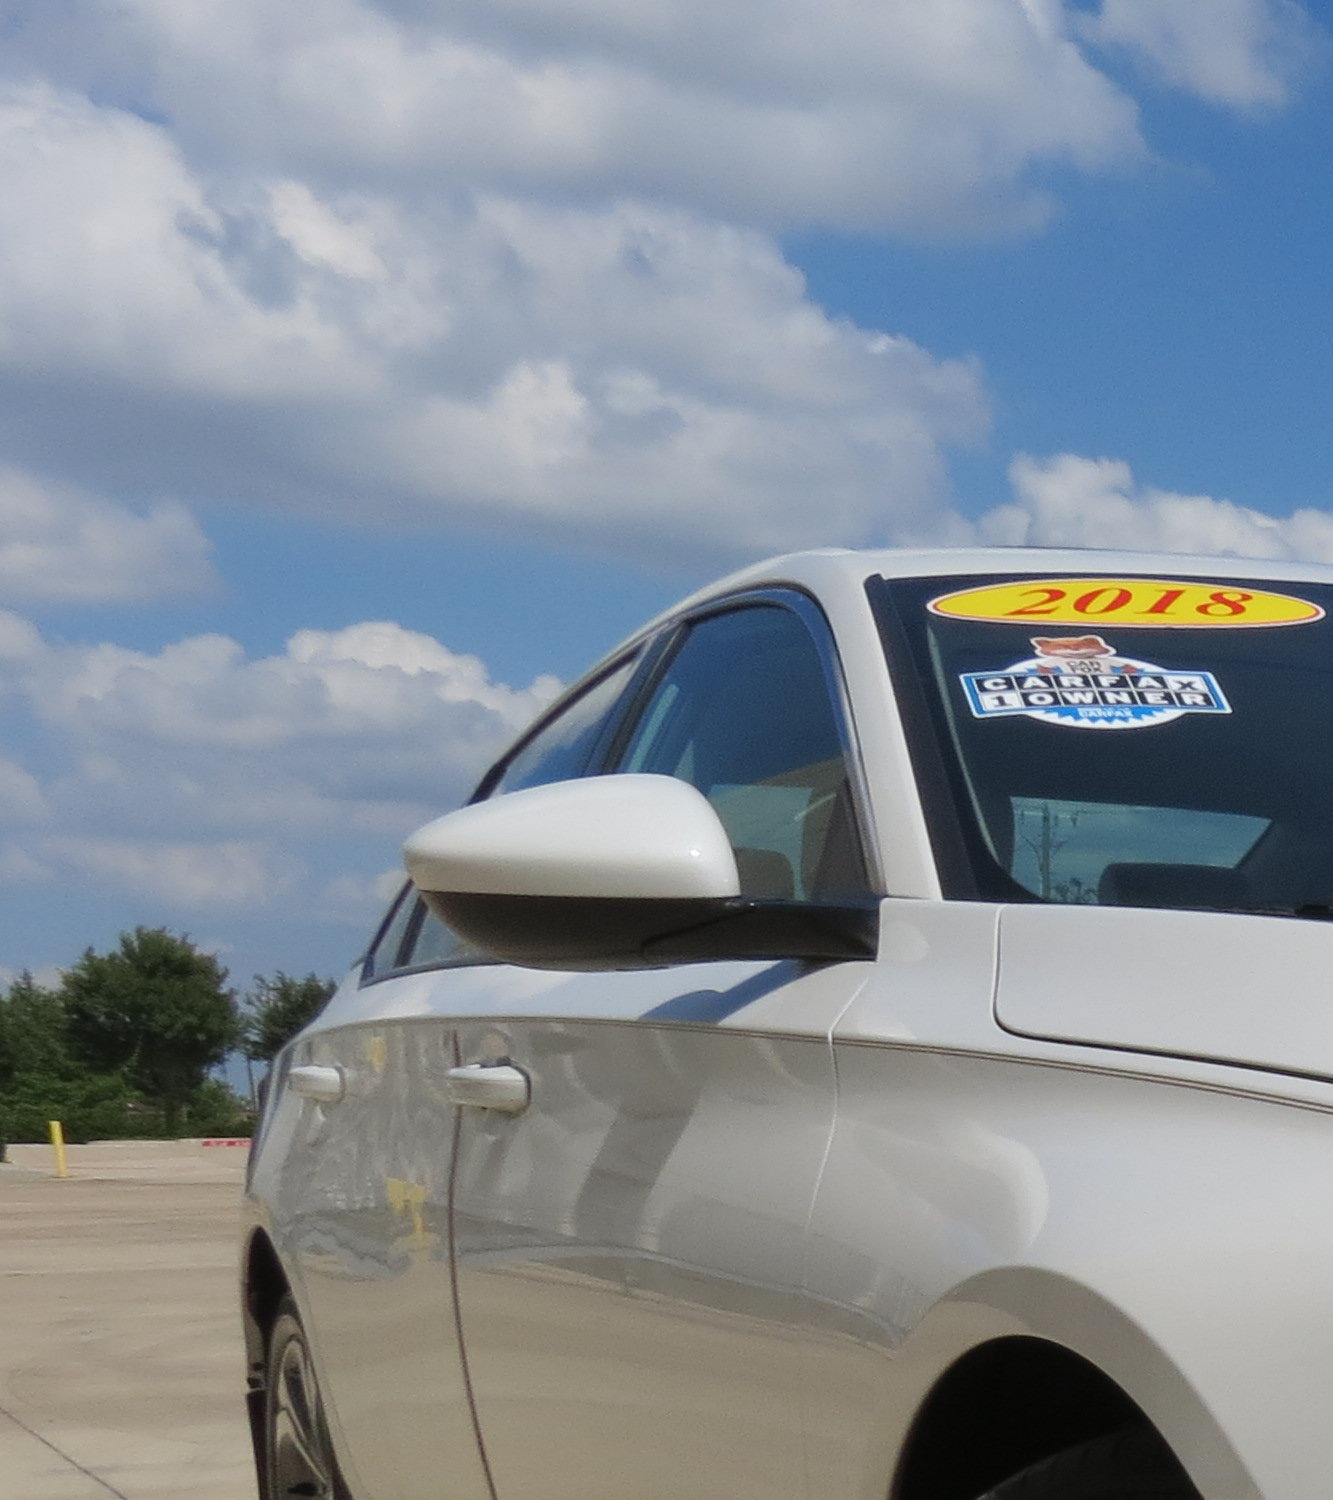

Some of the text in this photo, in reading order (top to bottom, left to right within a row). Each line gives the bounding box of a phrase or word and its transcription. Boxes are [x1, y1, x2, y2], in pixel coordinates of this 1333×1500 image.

[1003, 587, 1254, 617] 2018
[983, 676, 1199, 691] CARFAX
[991, 691, 1208, 708] 1 OWNER
